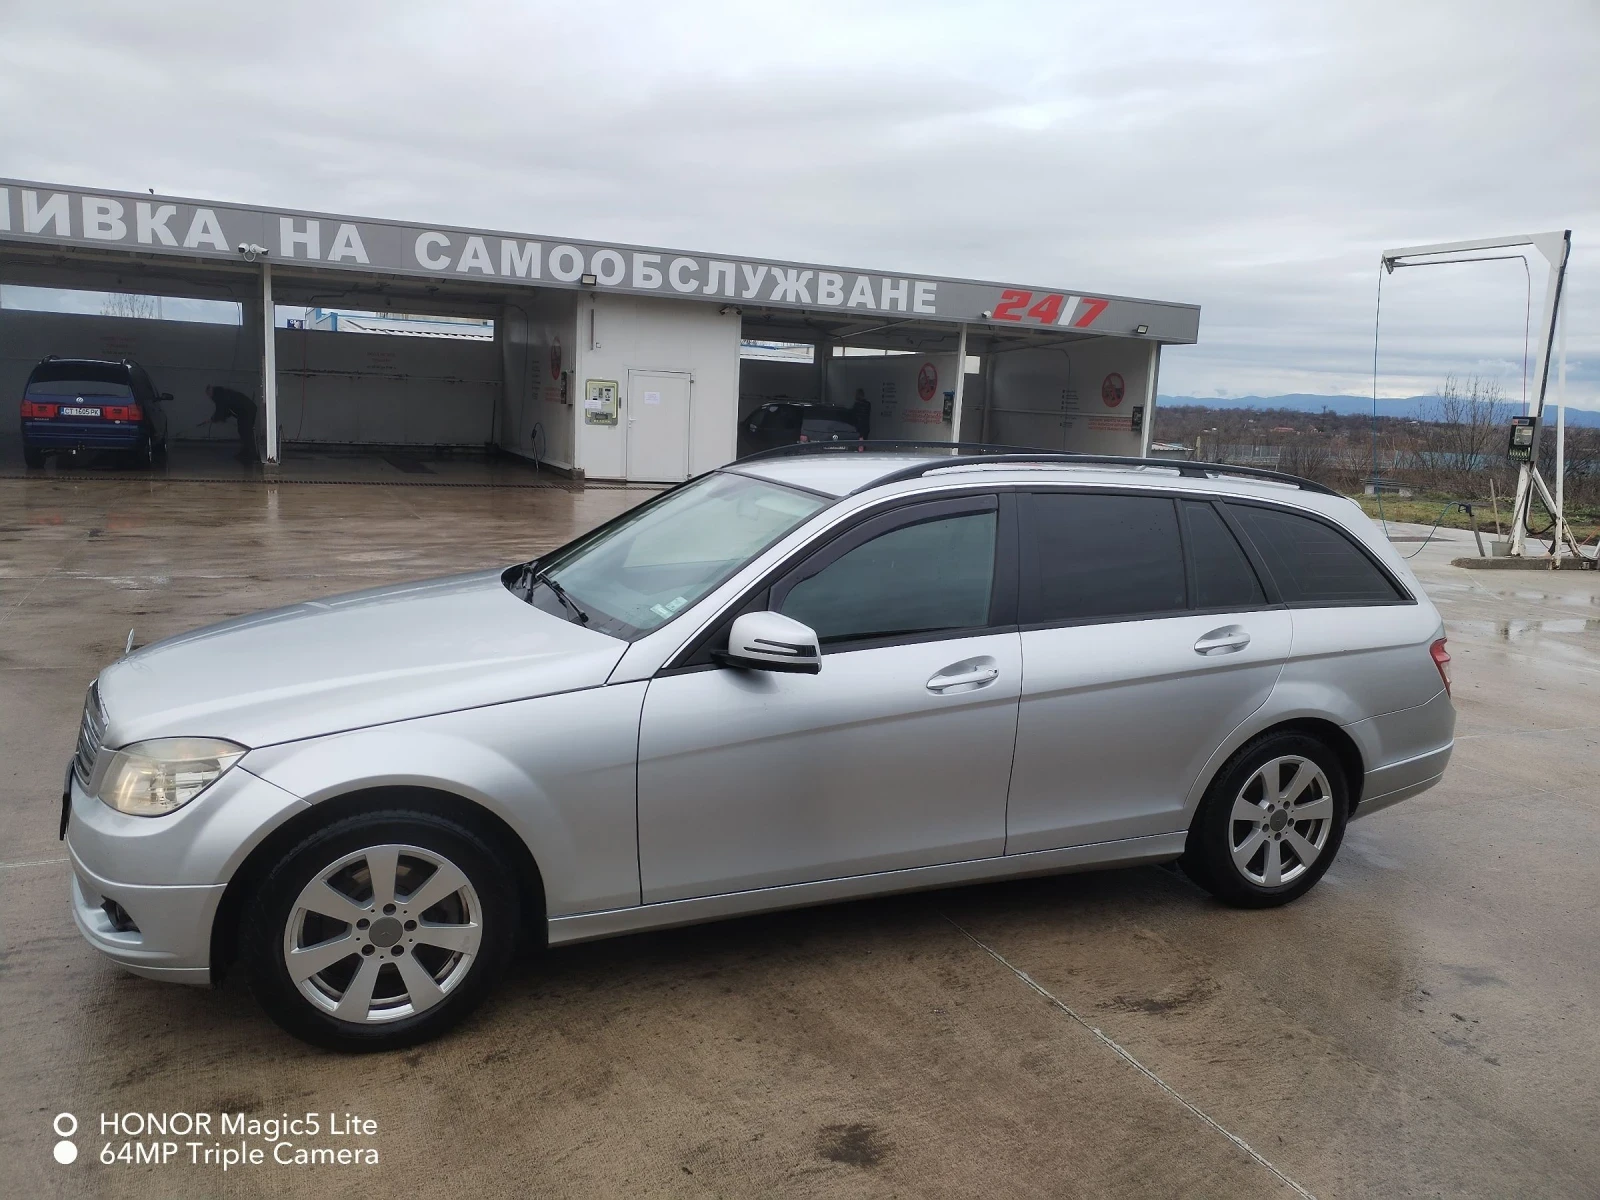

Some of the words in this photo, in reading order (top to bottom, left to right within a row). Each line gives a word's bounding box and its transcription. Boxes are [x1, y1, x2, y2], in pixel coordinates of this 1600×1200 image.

[0, 187, 230, 251] ИВКА
[279, 217, 371, 264] НА
[414, 231, 937, 314] САМООБСЛУЖВАНЕ
[991, 289, 1109, 328] 24/7
